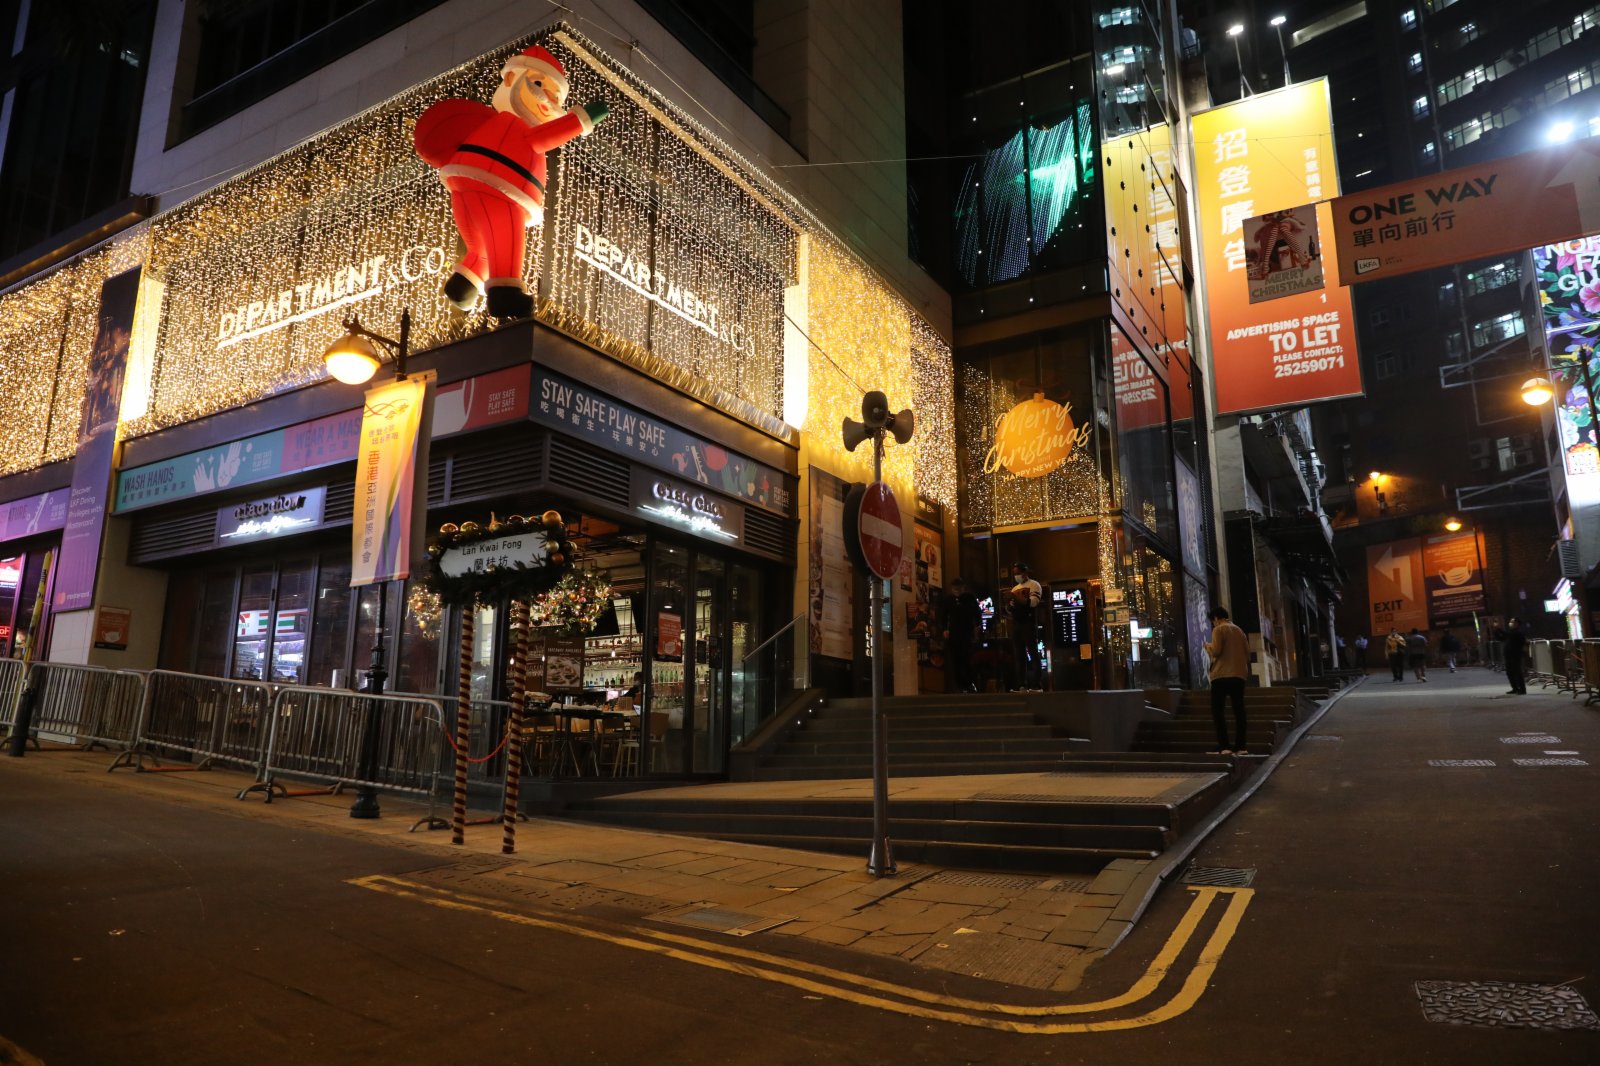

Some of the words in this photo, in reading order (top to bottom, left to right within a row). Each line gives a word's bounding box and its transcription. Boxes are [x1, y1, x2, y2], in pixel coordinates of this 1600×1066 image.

[1349, 193, 1416, 225] ONE
[1425, 174, 1498, 206] WAY
[1353, 209, 1456, 248] 單向前行
[575, 223, 719, 331] DEPARTMENT
[1252, 275, 1320, 298] CHRISTMAS
[1265, 269, 1304, 285] MERRY
[217, 254, 386, 341] DEPARTMENT
[1226, 318, 1300, 341] ADVERTISING
[1302, 311, 1339, 327] SPACE
[1268, 331, 1297, 353] TO
[1302, 323, 1341, 348] LET
[1273, 351, 1303, 363] PLEASE
[1304, 345, 1343, 358] CONTACT:
[1274, 355, 1345, 378] 25259071
[488, 392, 501, 402] STAY
[502, 388, 516, 398] SAFE
[337, 416, 361, 437] MAS
[541, 378, 573, 408] STAY
[575, 392, 606, 423] SAFE
[608, 407, 637, 435] PLAY
[638, 421, 666, 448] SAFE
[995, 401, 1073, 439] Merry
[983, 421, 1093, 474] Christmas
[124, 473, 146, 493] WASH
[147, 466, 175, 486] HANDS
[1003, 467, 1031, 482] HAPPY
[1033, 461, 1053, 473] NEW
[1056, 452, 1080, 467] YEAR
[462, 547, 476, 555] Lan
[479, 542, 499, 553] Kwai
[502, 540, 522, 550] Fong
[1374, 600, 1403, 613] EXIT
